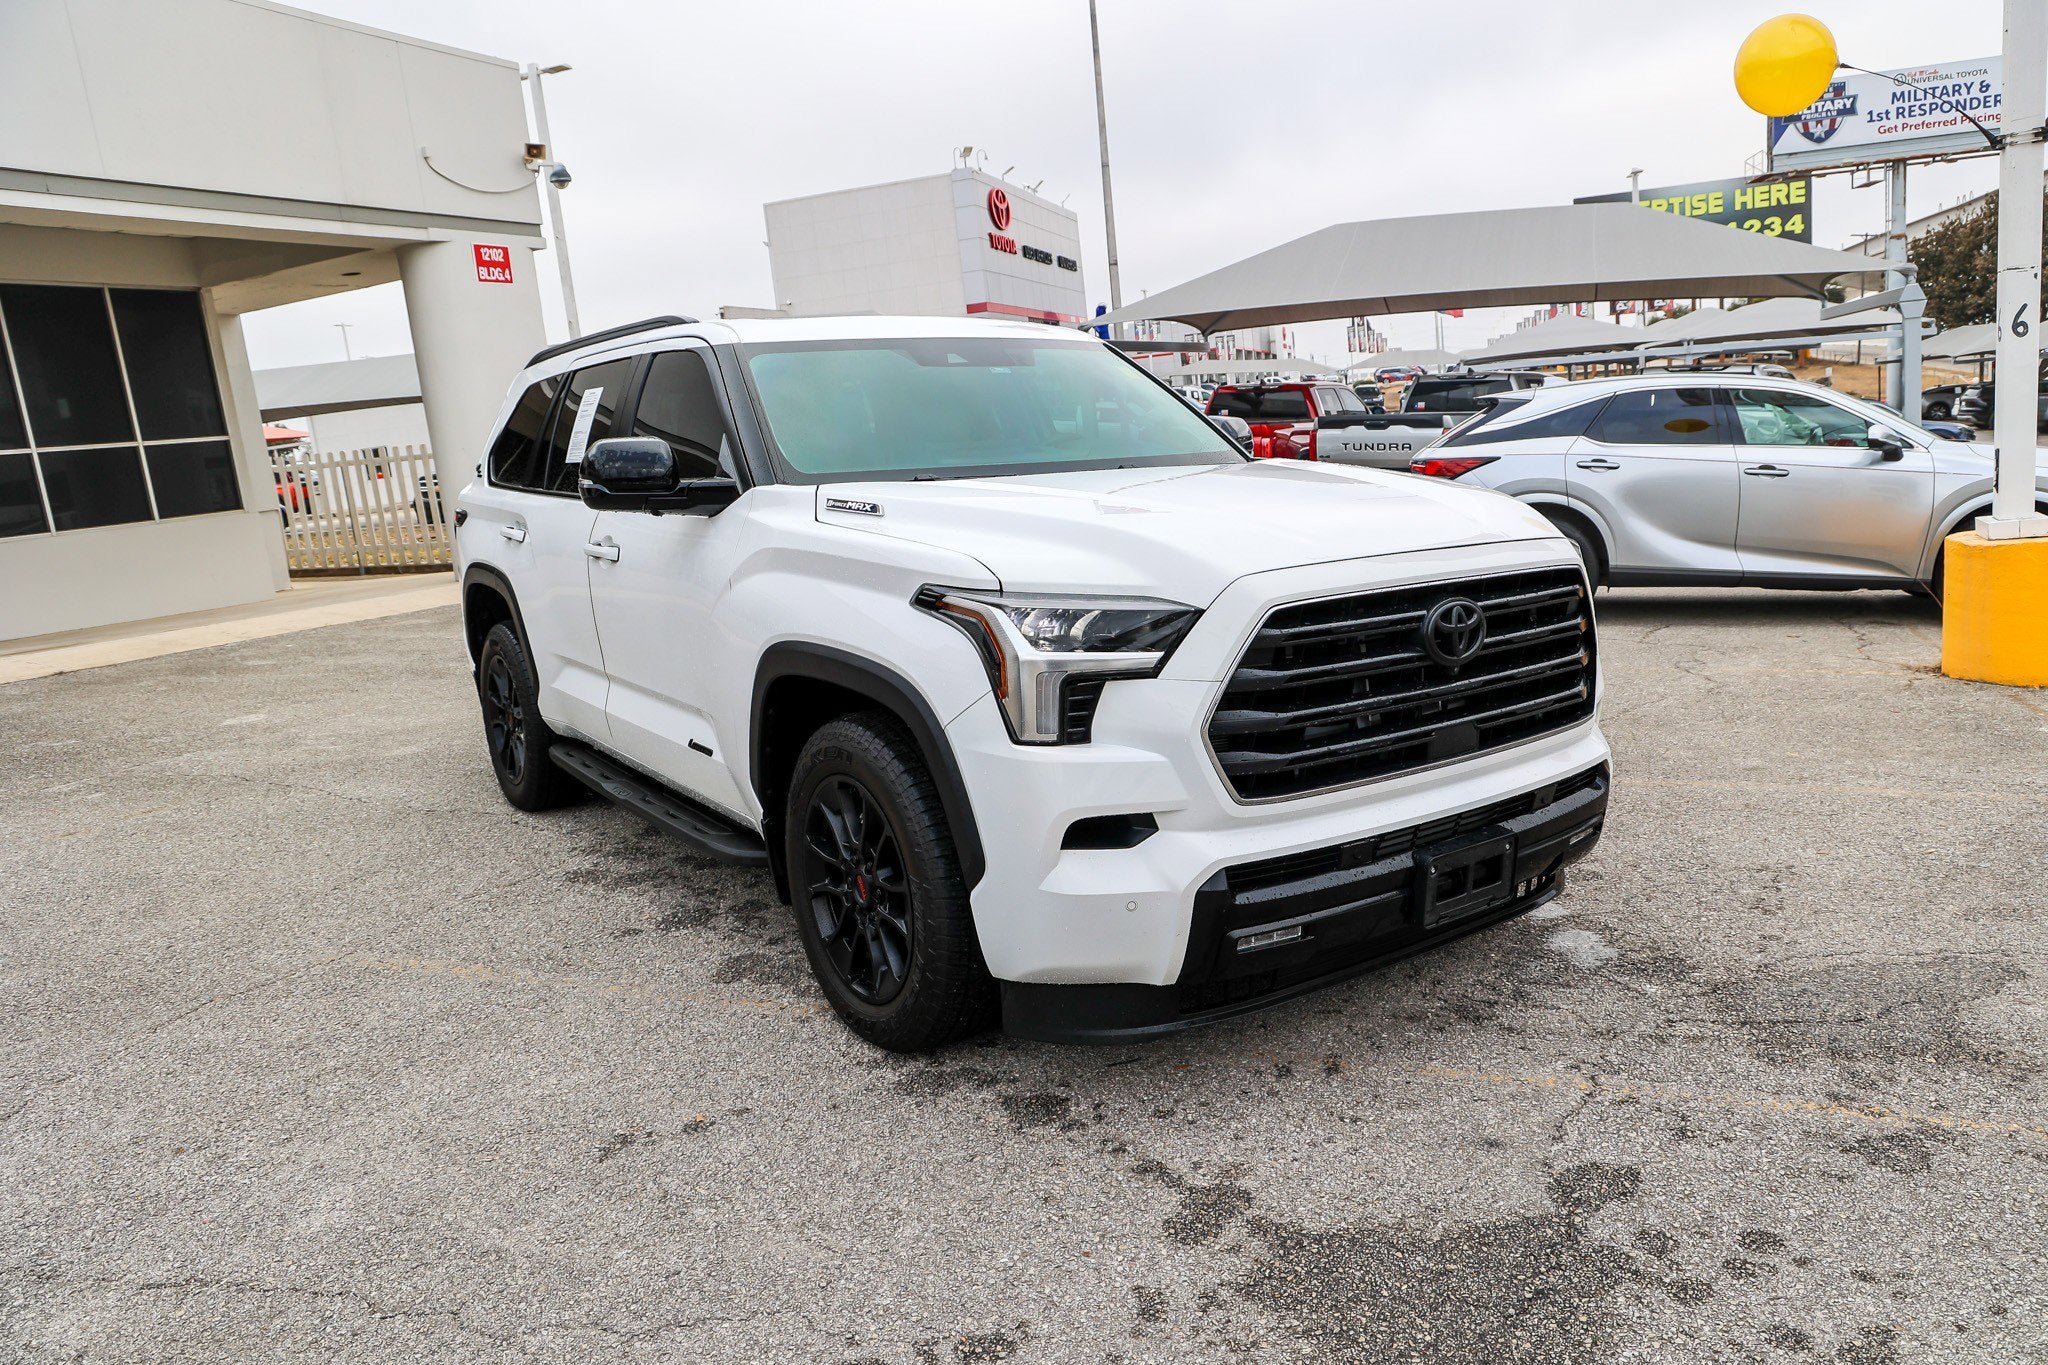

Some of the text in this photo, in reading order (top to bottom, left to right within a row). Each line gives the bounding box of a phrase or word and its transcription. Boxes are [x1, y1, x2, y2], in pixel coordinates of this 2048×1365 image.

[1908, 74, 1954, 85] UNIVERSAL
[1956, 68, 1989, 78] TOYOTA
[1891, 80, 1991, 105] MILITARY &
[1794, 97, 1854, 115] LITARY
[1867, 108, 1891, 123] 1st
[1877, 125, 1899, 134] Get
[1902, 116, 1957, 132] Preferred
[1734, 180, 1806, 211] HERE
[989, 232, 1017, 254] TOYOTA
[480, 247, 505, 262] 12102
[2011, 302, 2029, 338] 6
[1341, 442, 1412, 451] TUNDRA
